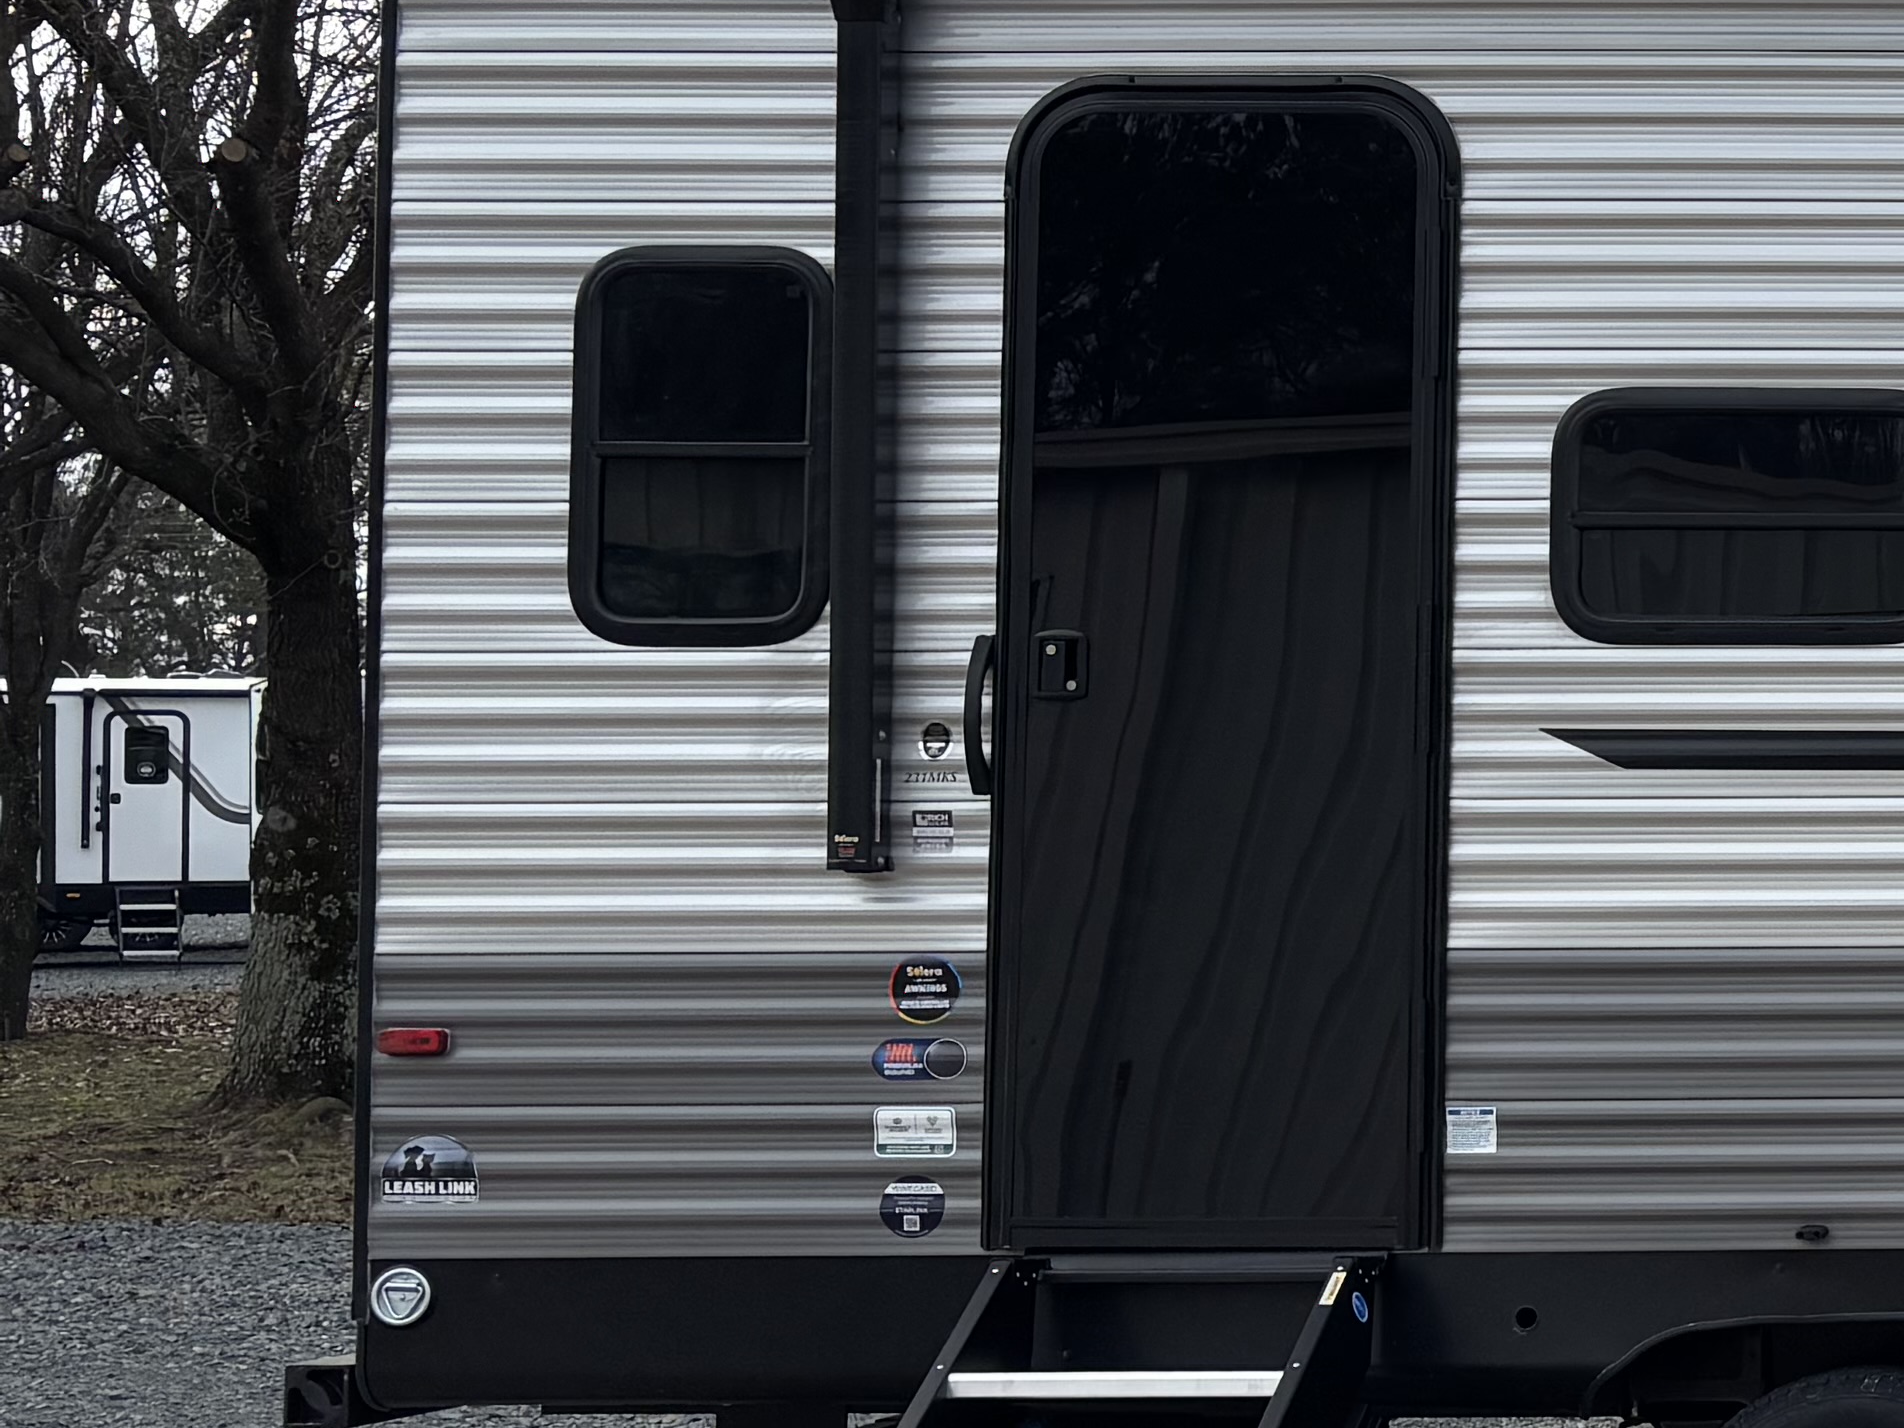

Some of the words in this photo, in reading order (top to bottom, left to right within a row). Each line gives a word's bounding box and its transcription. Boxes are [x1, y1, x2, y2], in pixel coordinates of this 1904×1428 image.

[906, 966, 943, 977] Solera
[384, 1181, 436, 1194] LEASH
[438, 1181, 476, 1194] LINK
